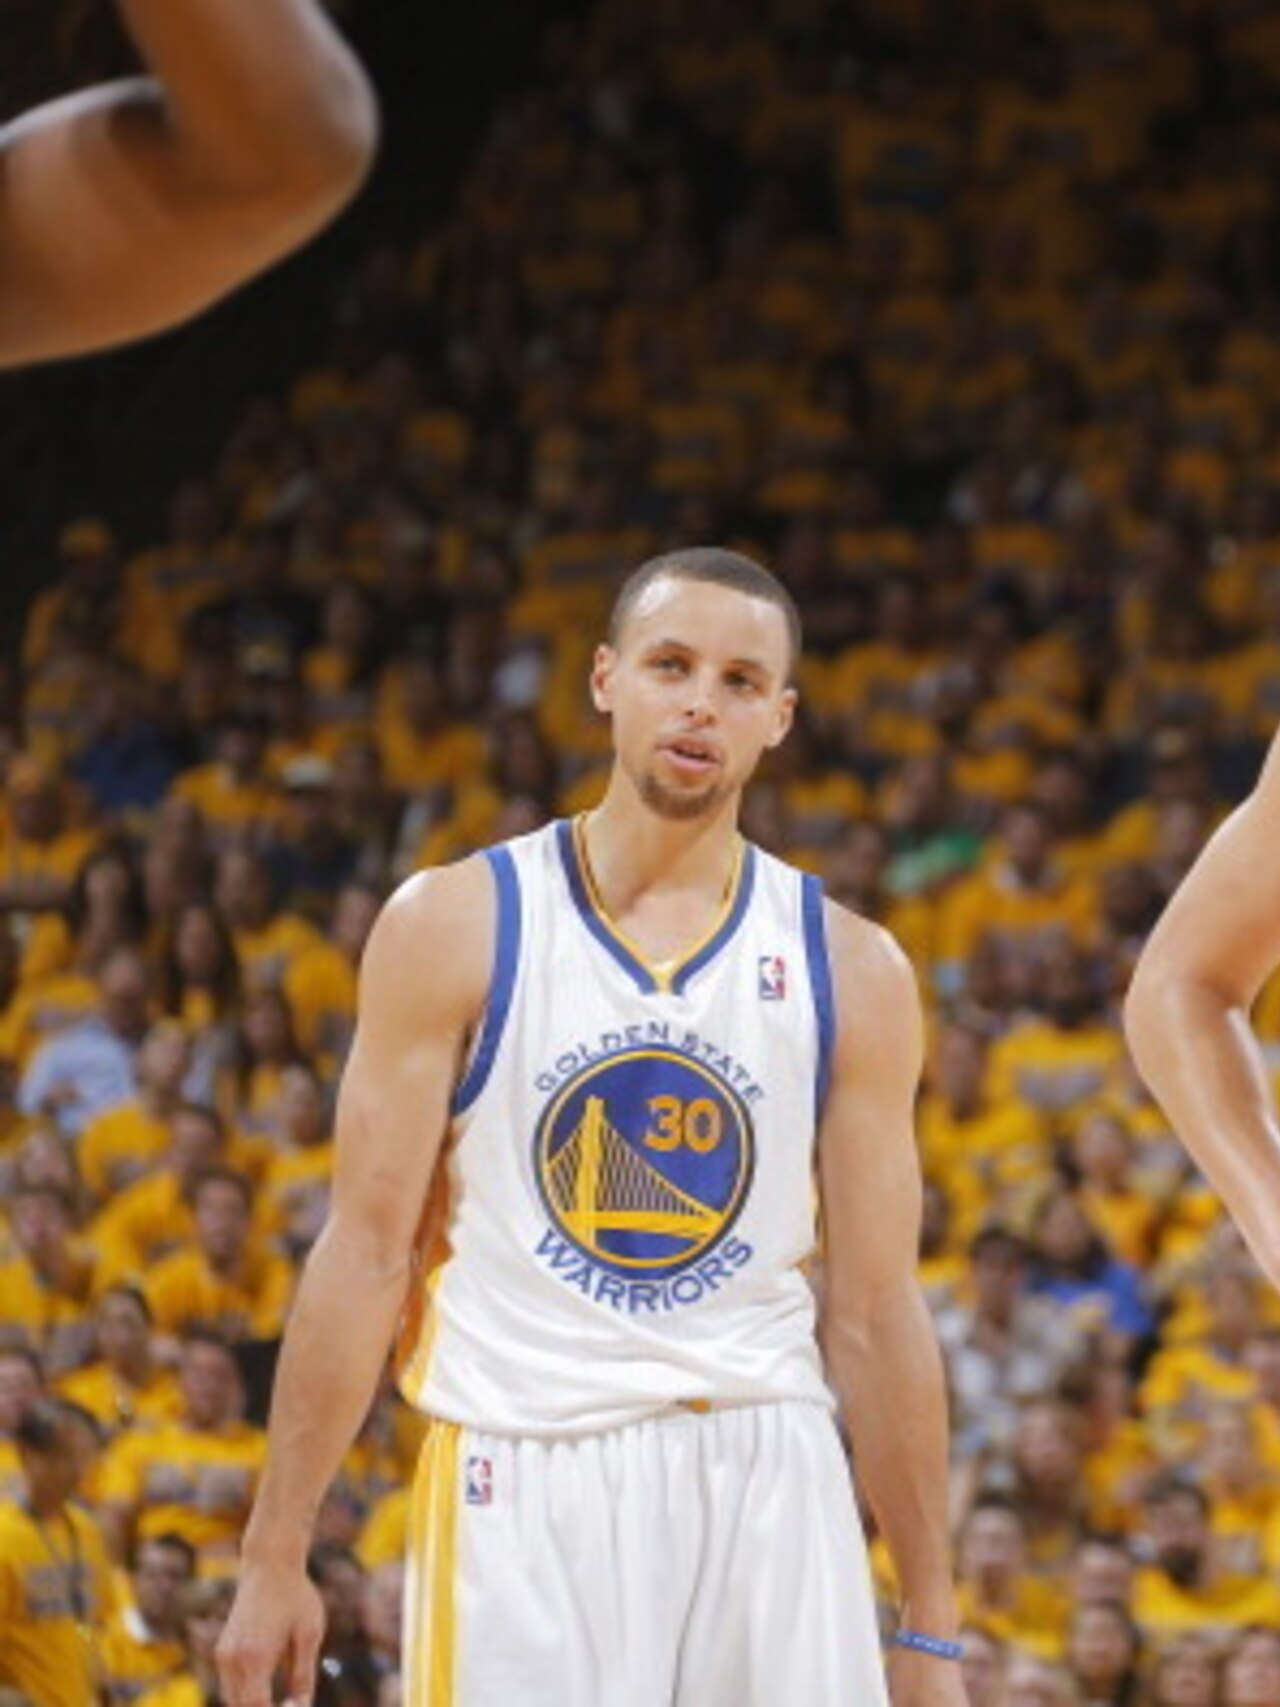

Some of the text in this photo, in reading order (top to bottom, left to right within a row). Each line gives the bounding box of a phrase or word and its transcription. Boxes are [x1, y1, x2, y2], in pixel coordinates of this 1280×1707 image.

[534, 1021, 764, 1104] GOLDEN STATE
[643, 1094, 723, 1154] 30
[534, 1229, 755, 1314] WARRIORS
